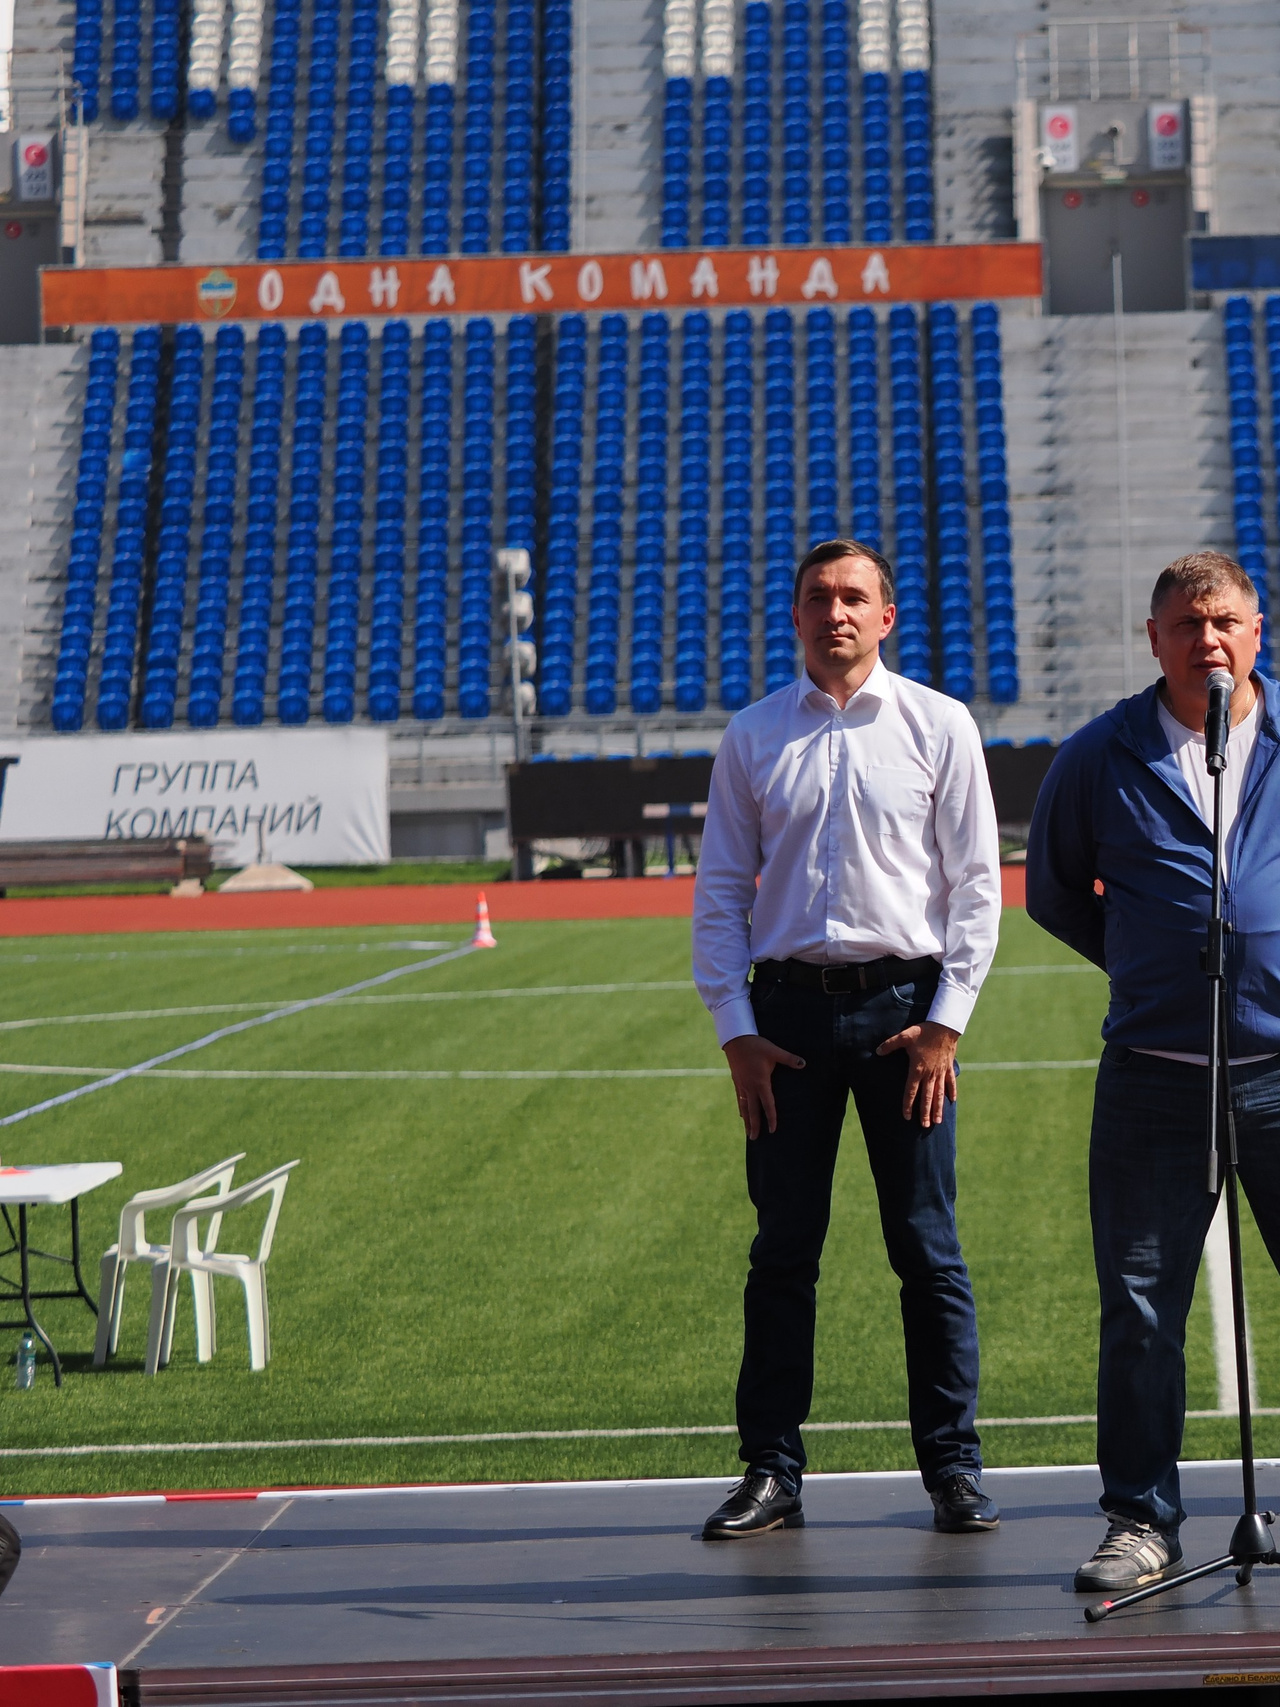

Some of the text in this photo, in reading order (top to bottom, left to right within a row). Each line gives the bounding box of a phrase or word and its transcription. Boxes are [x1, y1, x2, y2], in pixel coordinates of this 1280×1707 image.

[258, 252, 890, 314] ОДНА КОМАНДА
[112, 759, 260, 796] ГРУППА
[105, 794, 324, 839] КОМПАНИЙ
